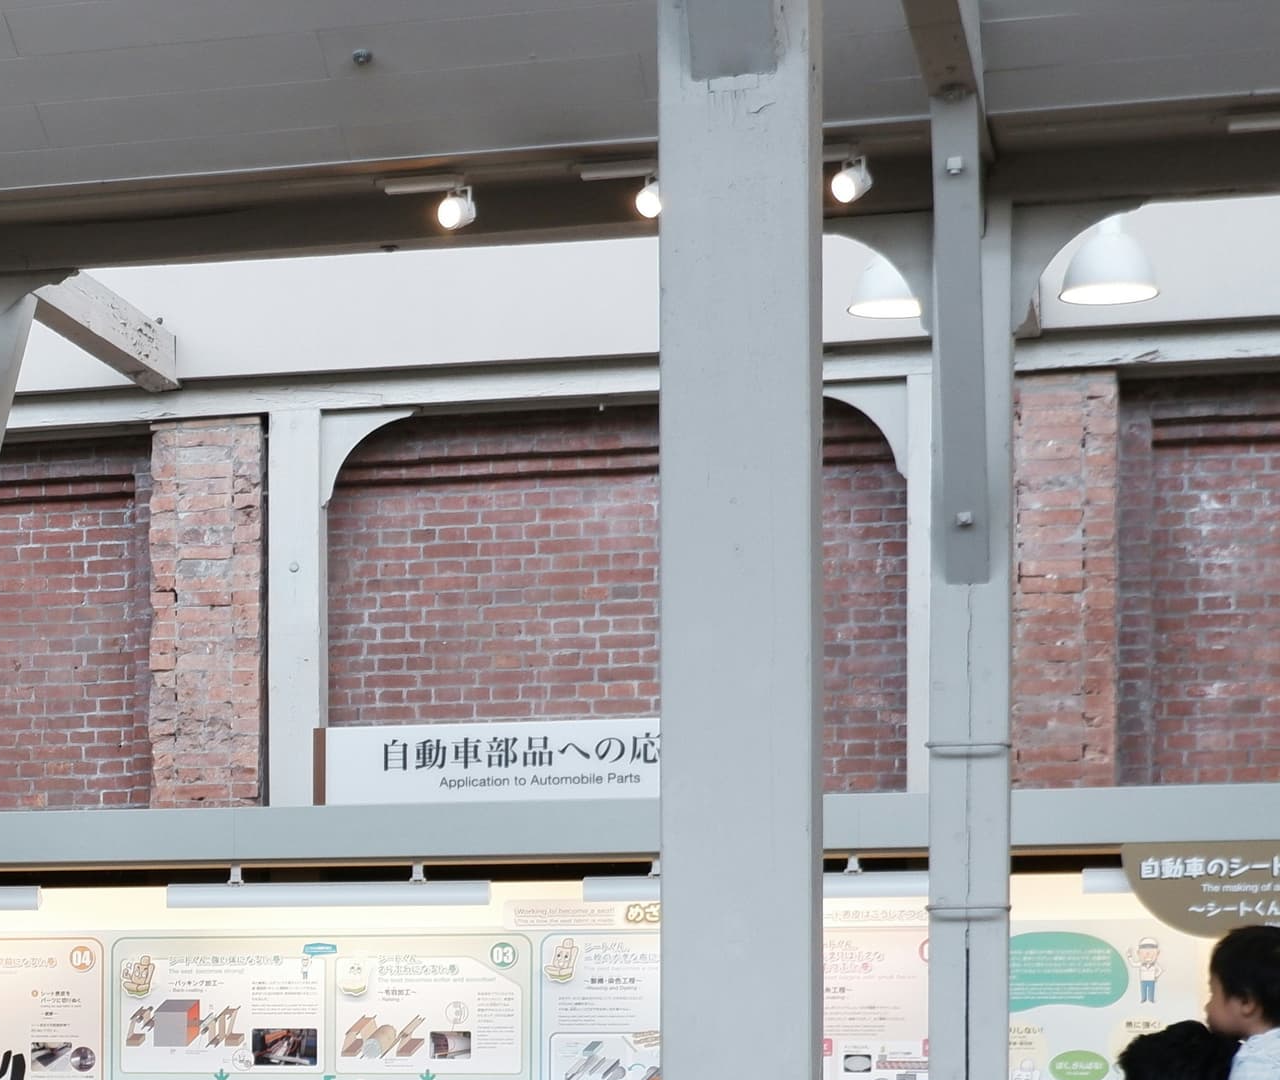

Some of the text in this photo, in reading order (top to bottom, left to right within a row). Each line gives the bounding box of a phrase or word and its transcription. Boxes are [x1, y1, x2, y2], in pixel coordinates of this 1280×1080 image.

[383, 732, 660, 771] 自動車部品への応
[439, 772, 641, 790] Application to Automobile Parts
[1201, 884, 1220, 892] The
[1222, 883, 1259, 894] making
[1261, 883, 1272, 892] of
[73, 951, 91, 966] 04
[493, 947, 513, 963] 03
